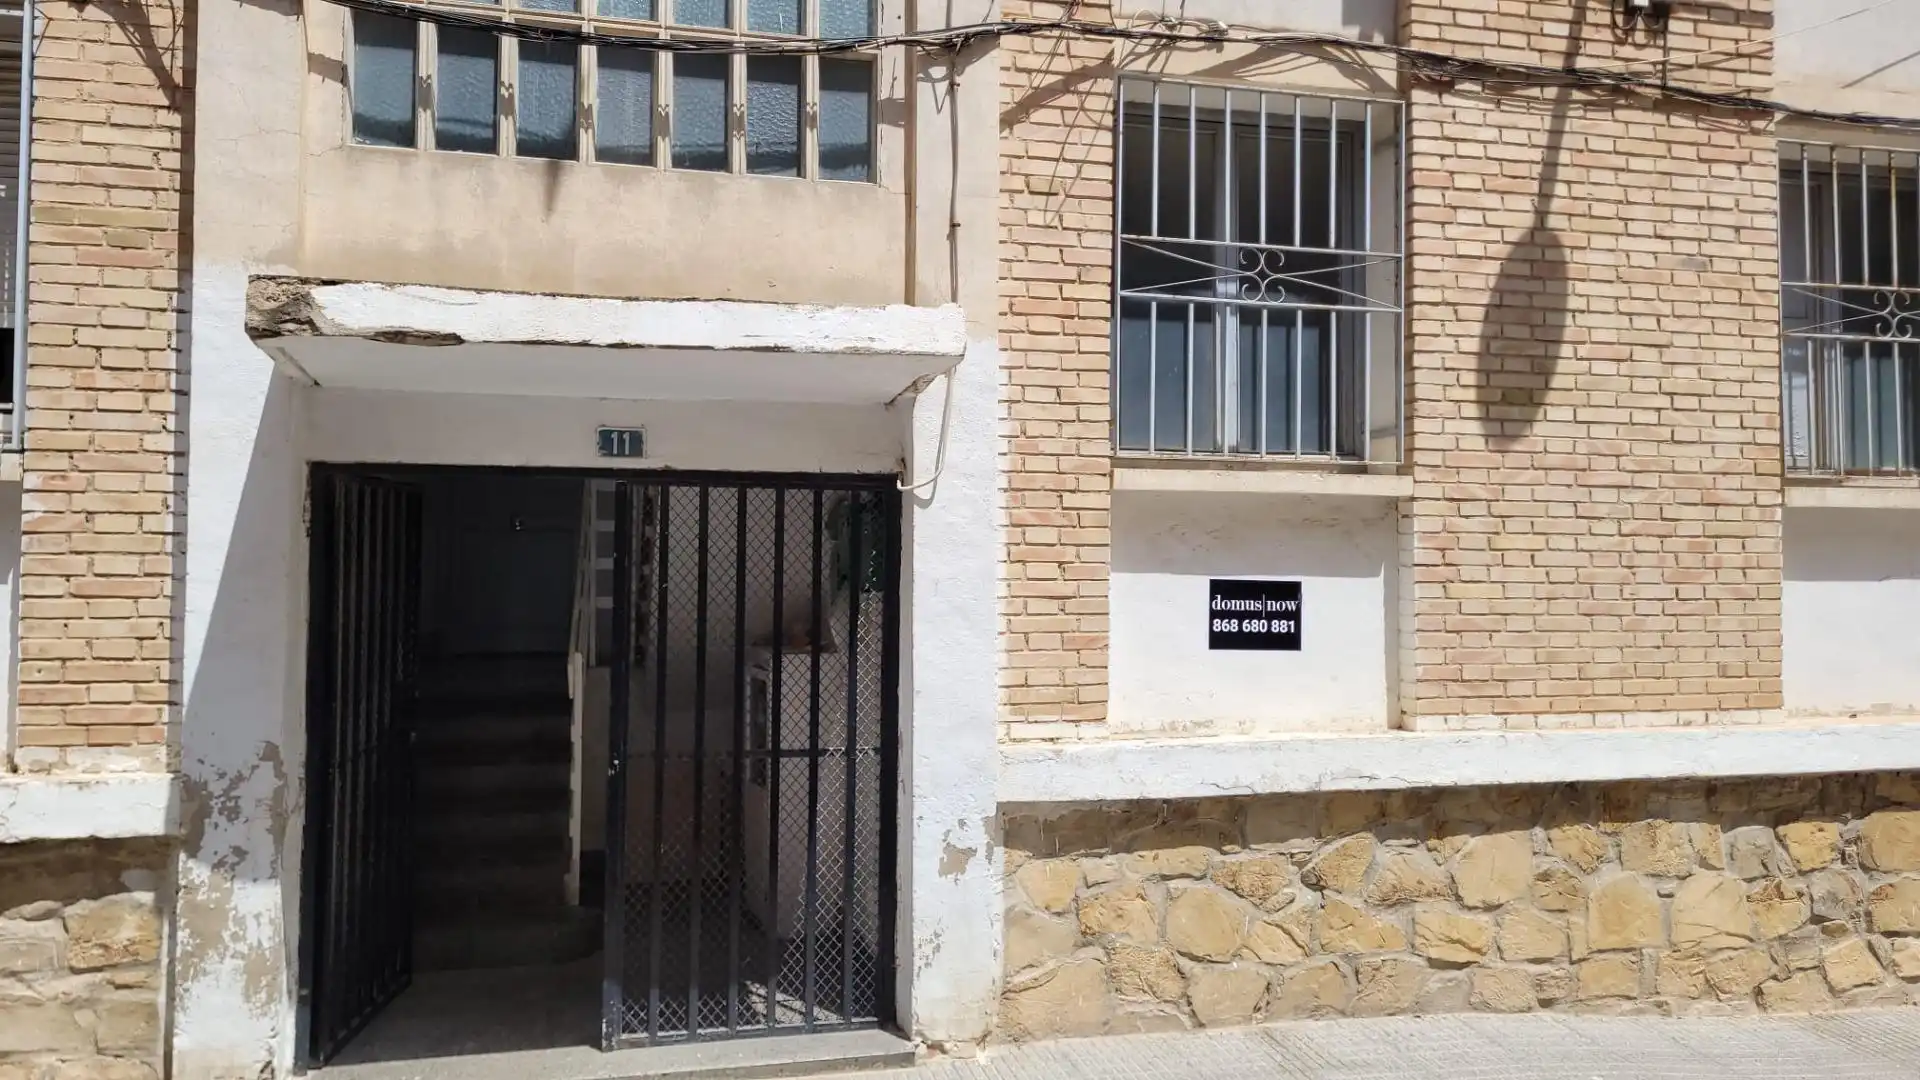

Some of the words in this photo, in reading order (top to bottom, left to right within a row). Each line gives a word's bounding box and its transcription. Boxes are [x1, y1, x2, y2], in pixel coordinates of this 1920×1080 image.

[611, 431, 630, 455] 11
[1212, 618, 1239, 632] 868
[1242, 619, 1268, 633] 680
[1271, 619, 1295, 633] 881
